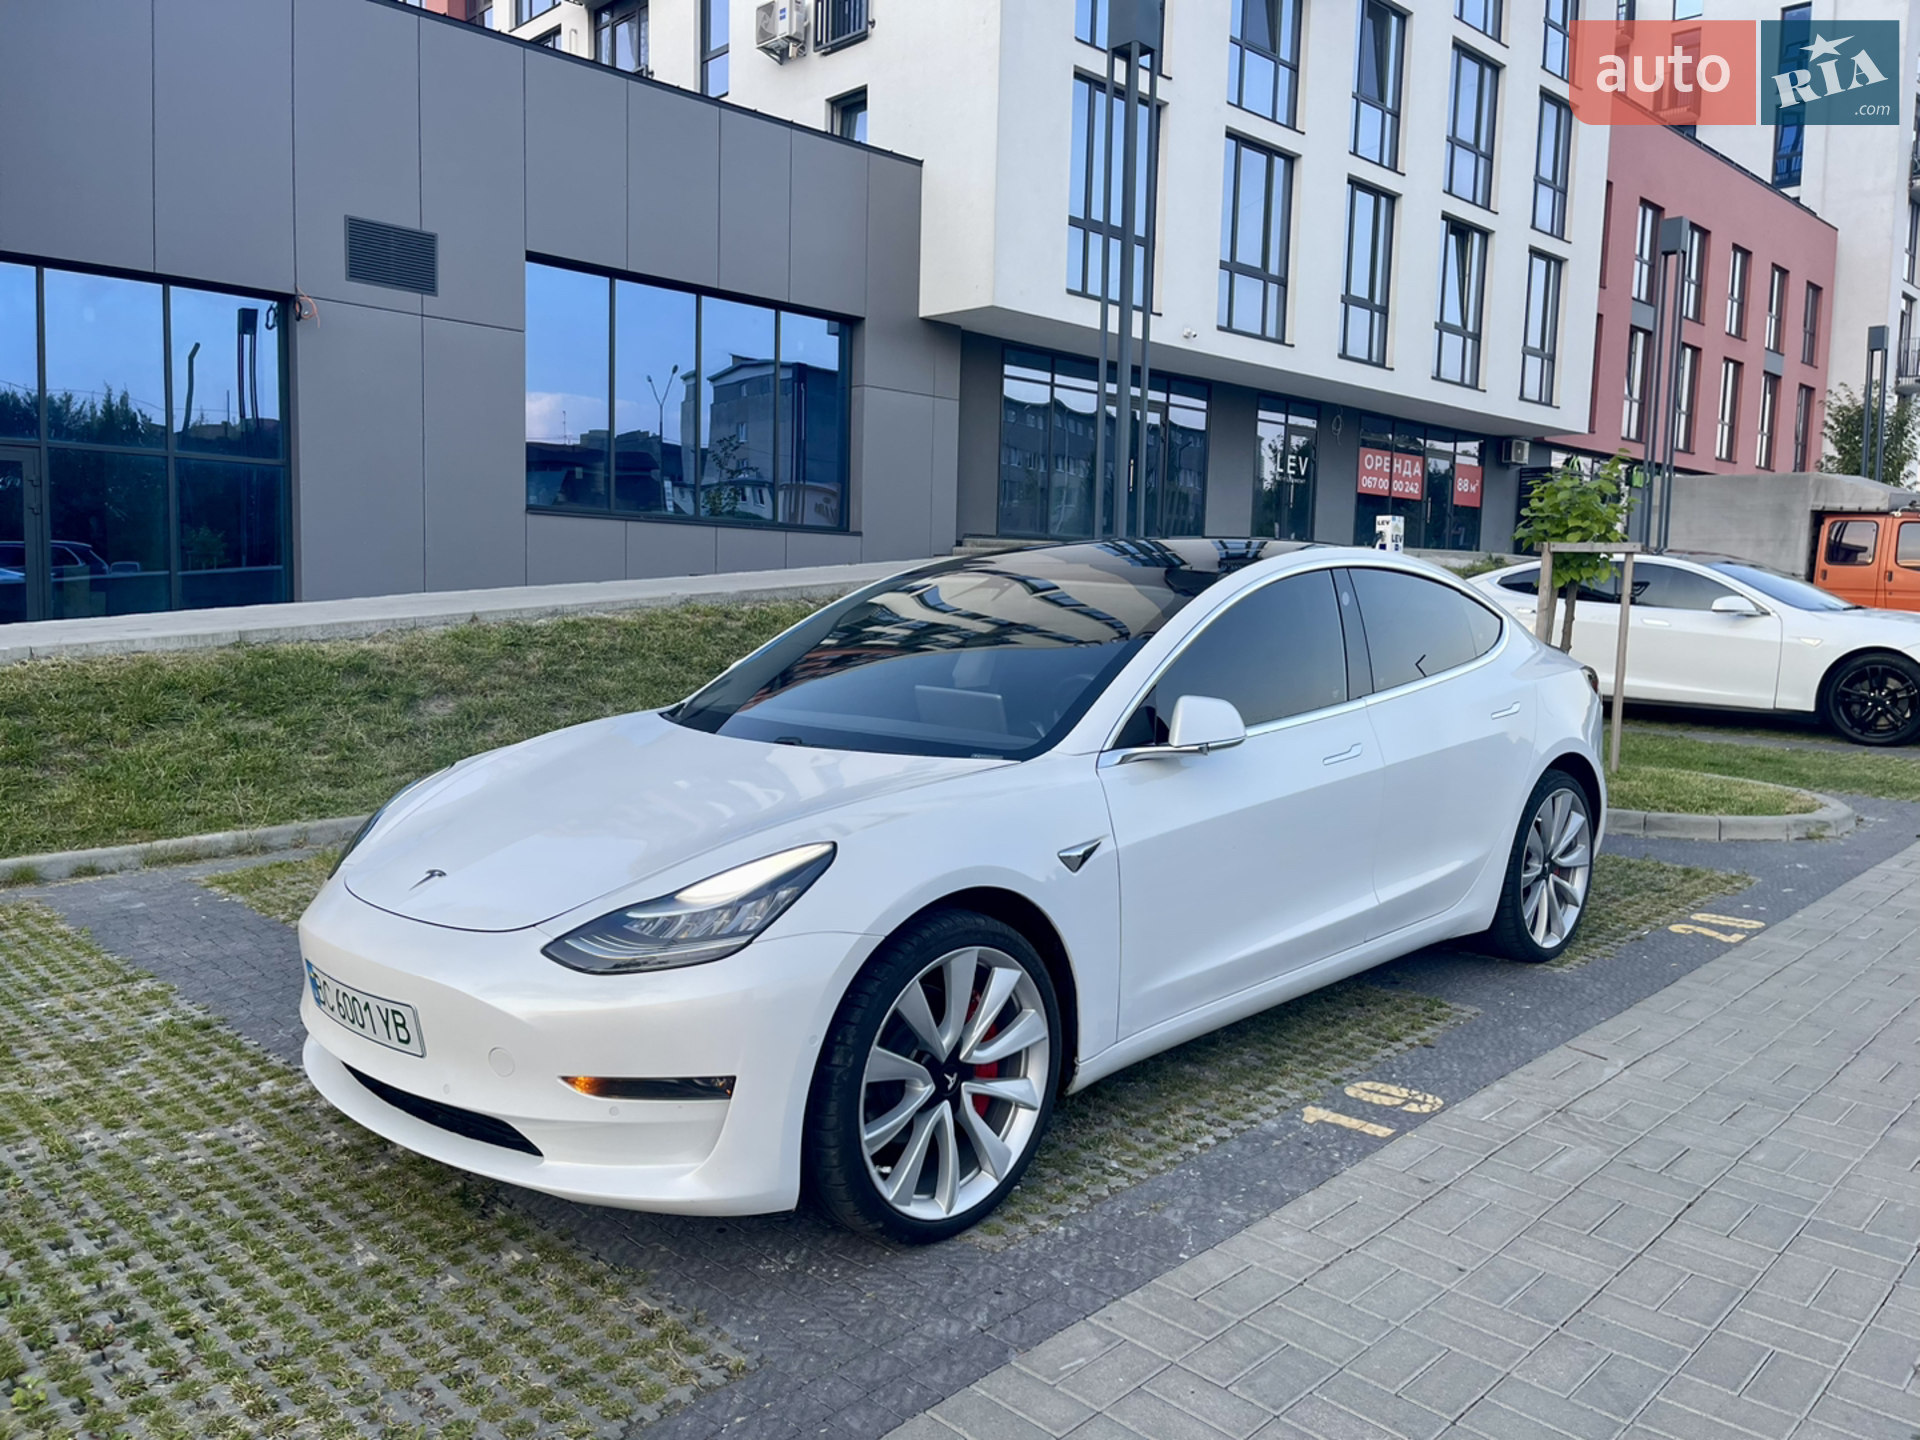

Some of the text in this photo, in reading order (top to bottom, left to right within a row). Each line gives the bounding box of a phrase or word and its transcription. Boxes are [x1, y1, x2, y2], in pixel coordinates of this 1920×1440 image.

[1276, 452, 1309, 476] LEV
[1364, 453, 1422, 478] ОРЕНДА
[1457, 477, 1470, 493] 88
[336, 988, 377, 1035] 6001
[376, 1004, 412, 1045] YB
